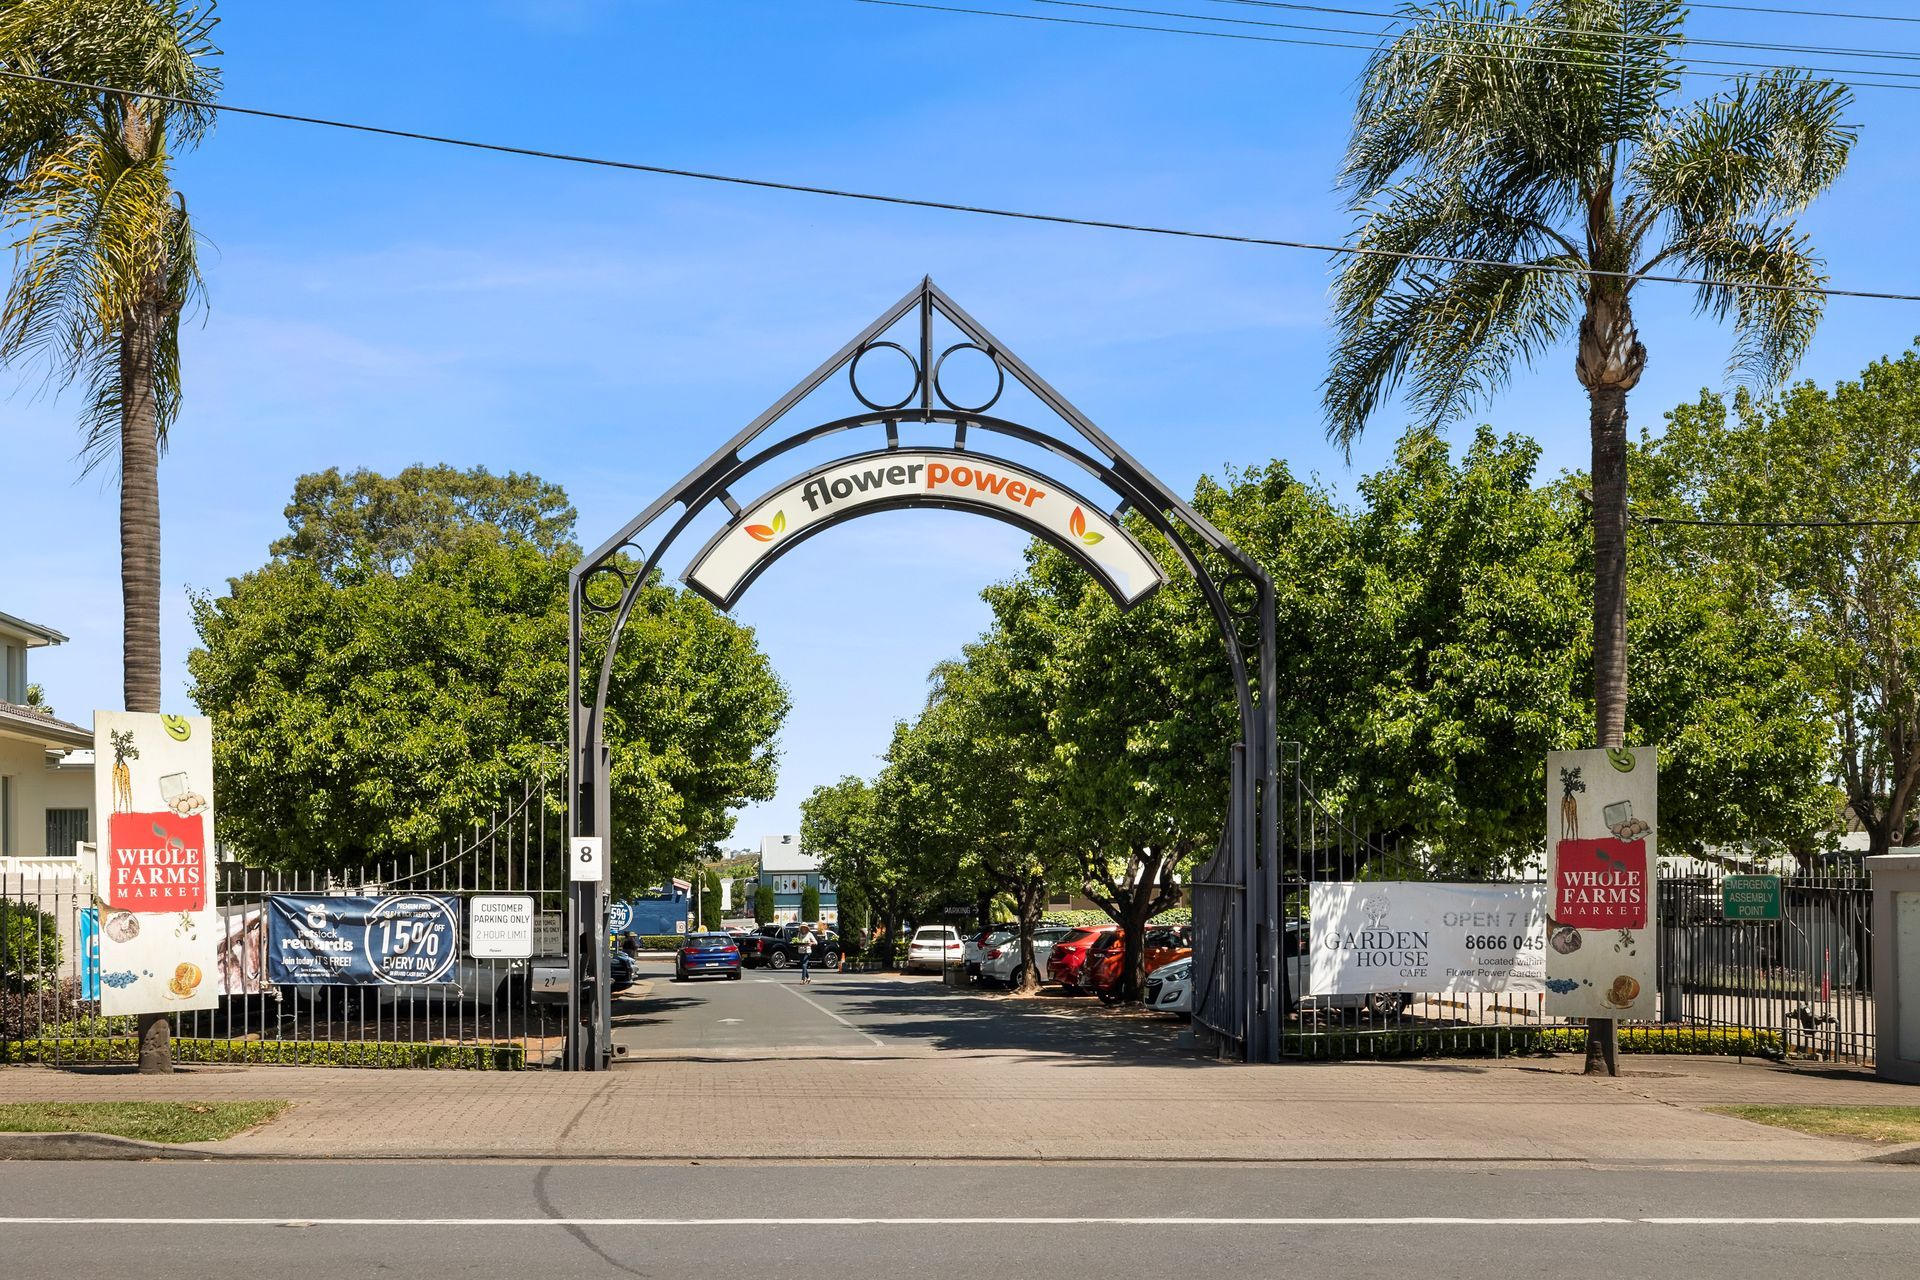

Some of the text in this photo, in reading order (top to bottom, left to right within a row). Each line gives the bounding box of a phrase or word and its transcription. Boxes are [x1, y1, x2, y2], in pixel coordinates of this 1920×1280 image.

[116, 848, 199, 866] WHOLE
[580, 846, 593, 863] 8
[116, 867, 200, 885] FARMS
[1563, 870, 1641, 887] WHOLE
[1725, 879, 1777, 890] EMERGENCY
[117, 887, 200, 898] MARKET
[1563, 888, 1641, 904] FARMS
[1729, 892, 1774, 903] ASSEMBLY
[481, 903, 523, 912] CUSTOMER
[609, 907, 626, 920] 5%
[1563, 906, 1641, 915] MARKET
[1739, 905, 1765, 916] POINT
[474, 914, 530, 924] PARKING ONLY
[1443, 911, 1500, 928] OPEN
[1506, 911, 1517, 928] 7
[379, 919, 446, 956] 15% OFF
[476, 930, 527, 940] 2 HOUR LIMIT
[1324, 931, 1429, 951] GARDEN
[281, 938, 354, 951] rewards
[1465, 935, 1544, 951] 8666 045
[281, 956, 295, 965] Join
[295, 956, 313, 966] today
[329, 956, 352, 967] FREE!
[383, 956, 437, 971] EVERY DAY
[1356, 951, 1429, 967] HOUSE
[1478, 957, 1542, 966] Located within
[1399, 968, 1428, 978] CAFE
[1446, 967, 1542, 978] Flower Power Garden
[544, 976, 557, 988] 27
